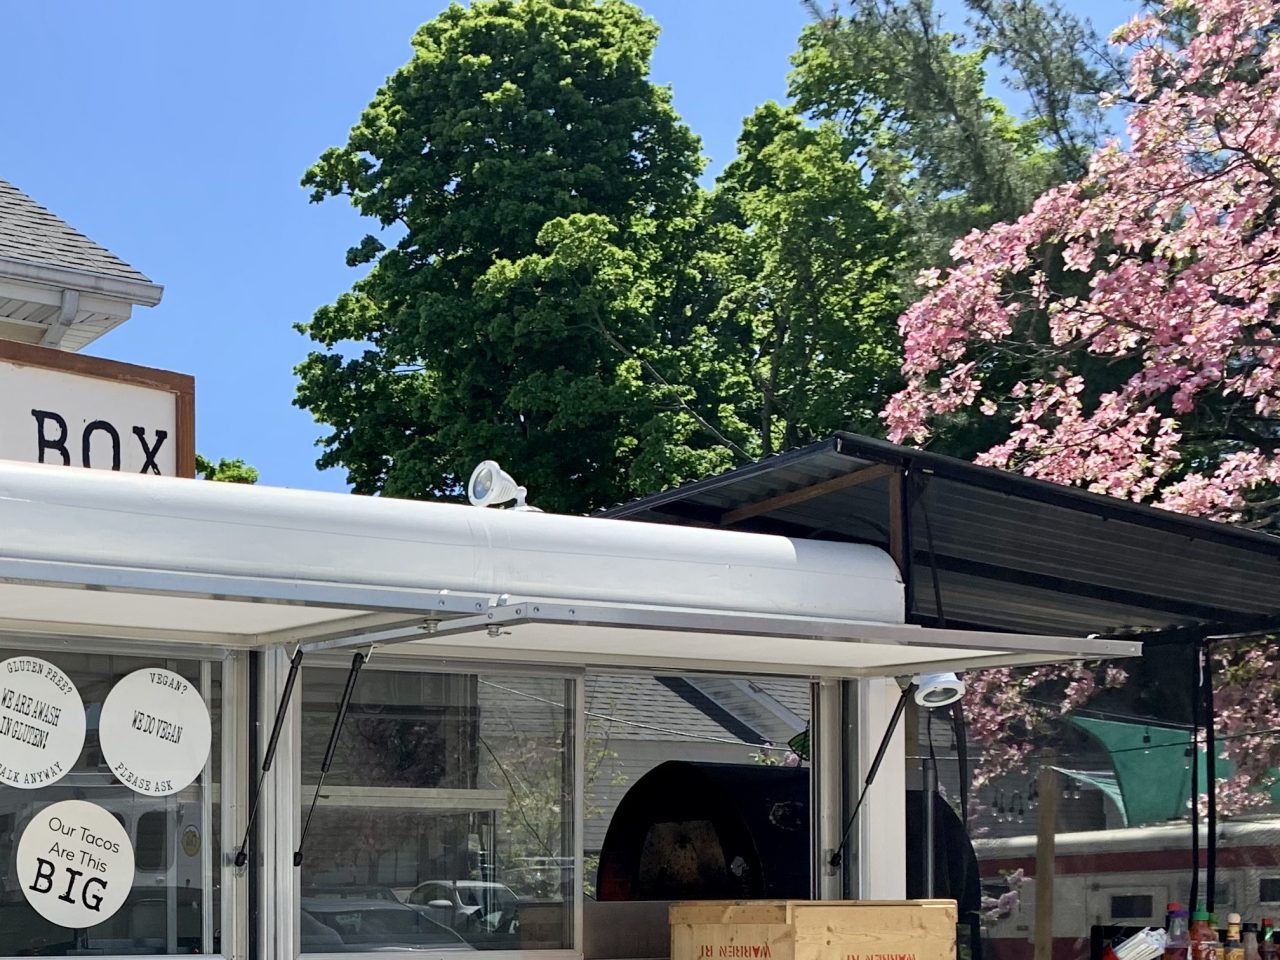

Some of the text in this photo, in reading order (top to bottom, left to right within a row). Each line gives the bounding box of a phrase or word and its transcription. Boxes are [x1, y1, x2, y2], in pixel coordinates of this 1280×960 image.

[31, 408, 168, 475] BOX
[6, 660, 73, 695] GLUTEN FREE?
[149, 672, 188, 695] VEGAN?
[0, 687, 62, 727] WE ARE AWASH
[11, 720, 49, 750] GLUTEN!
[131, 709, 183, 744] WE DO VEGAN
[24, 761, 63, 784] ANYWAY
[114, 762, 173, 792] PLEASE ASK
[48, 817, 120, 854] Our Tacos
[48, 841, 108, 873] Are This
[29, 857, 108, 912] BIG
[719, 944, 771, 959] WARREN
